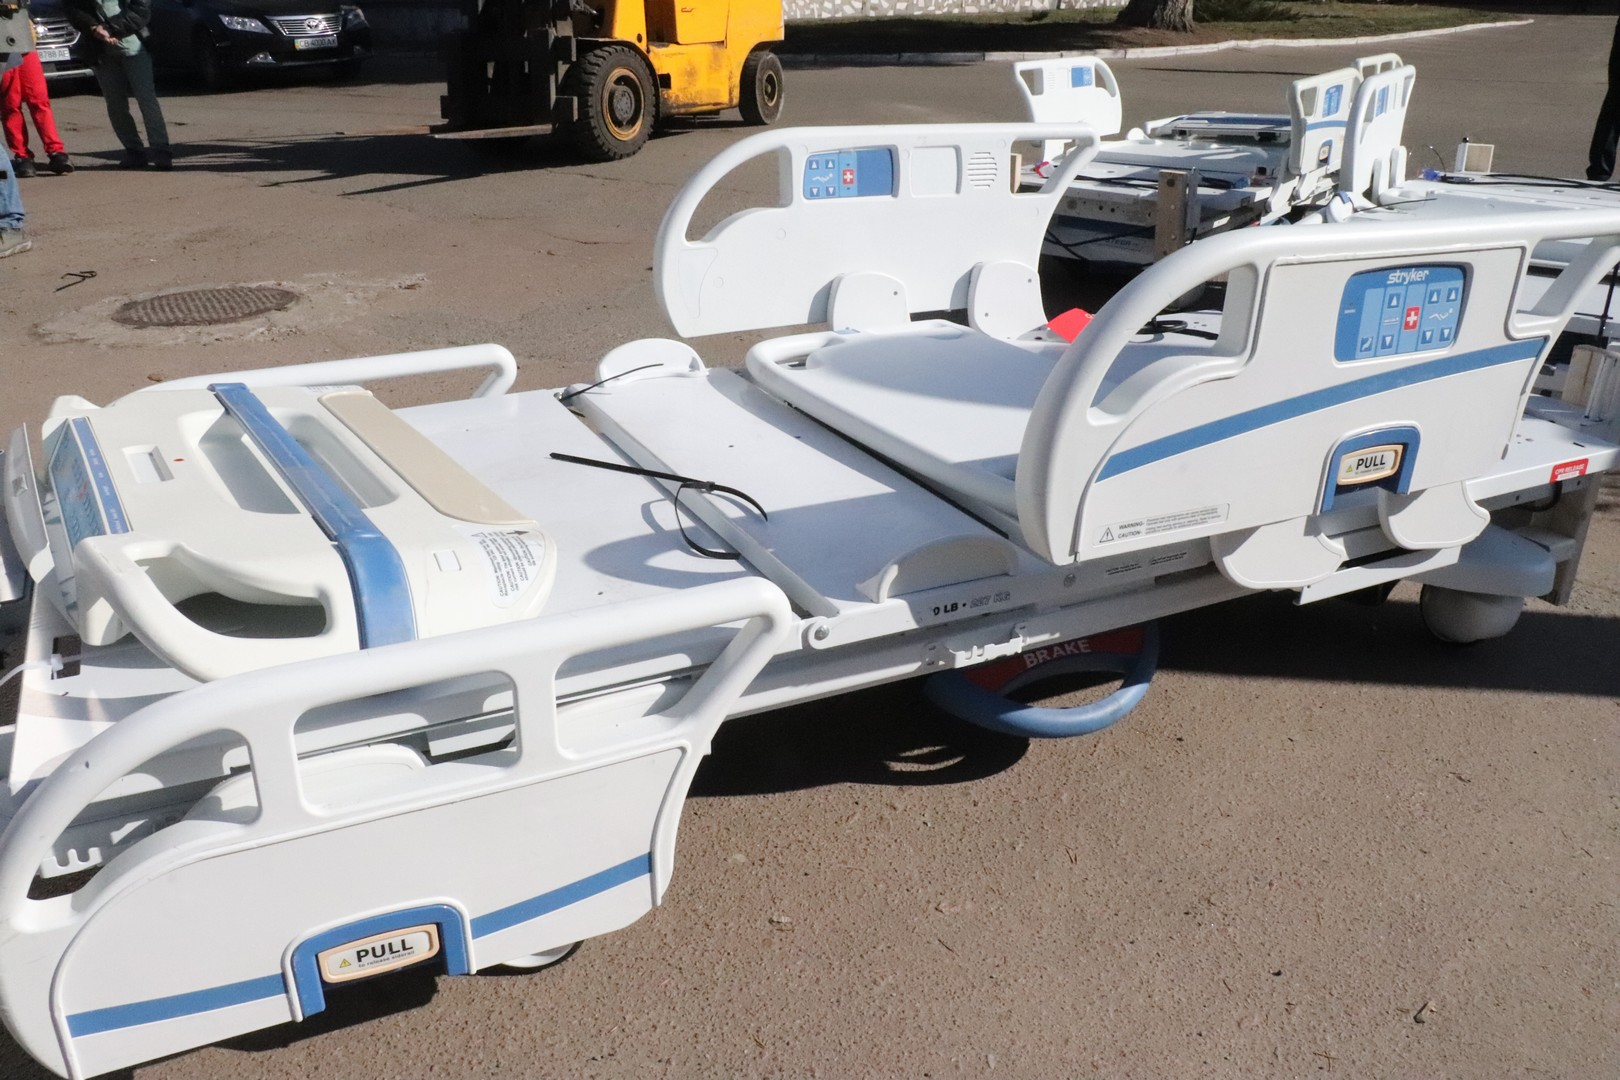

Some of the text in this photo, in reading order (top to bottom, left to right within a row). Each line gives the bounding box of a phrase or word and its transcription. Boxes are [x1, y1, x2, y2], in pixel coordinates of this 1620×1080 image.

[1387, 268, 1429, 285] stryker
[1356, 454, 1386, 470] PULL
[943, 602, 958, 614] LB
[1023, 640, 1092, 669] BRAKE
[356, 939, 413, 963] PULL
